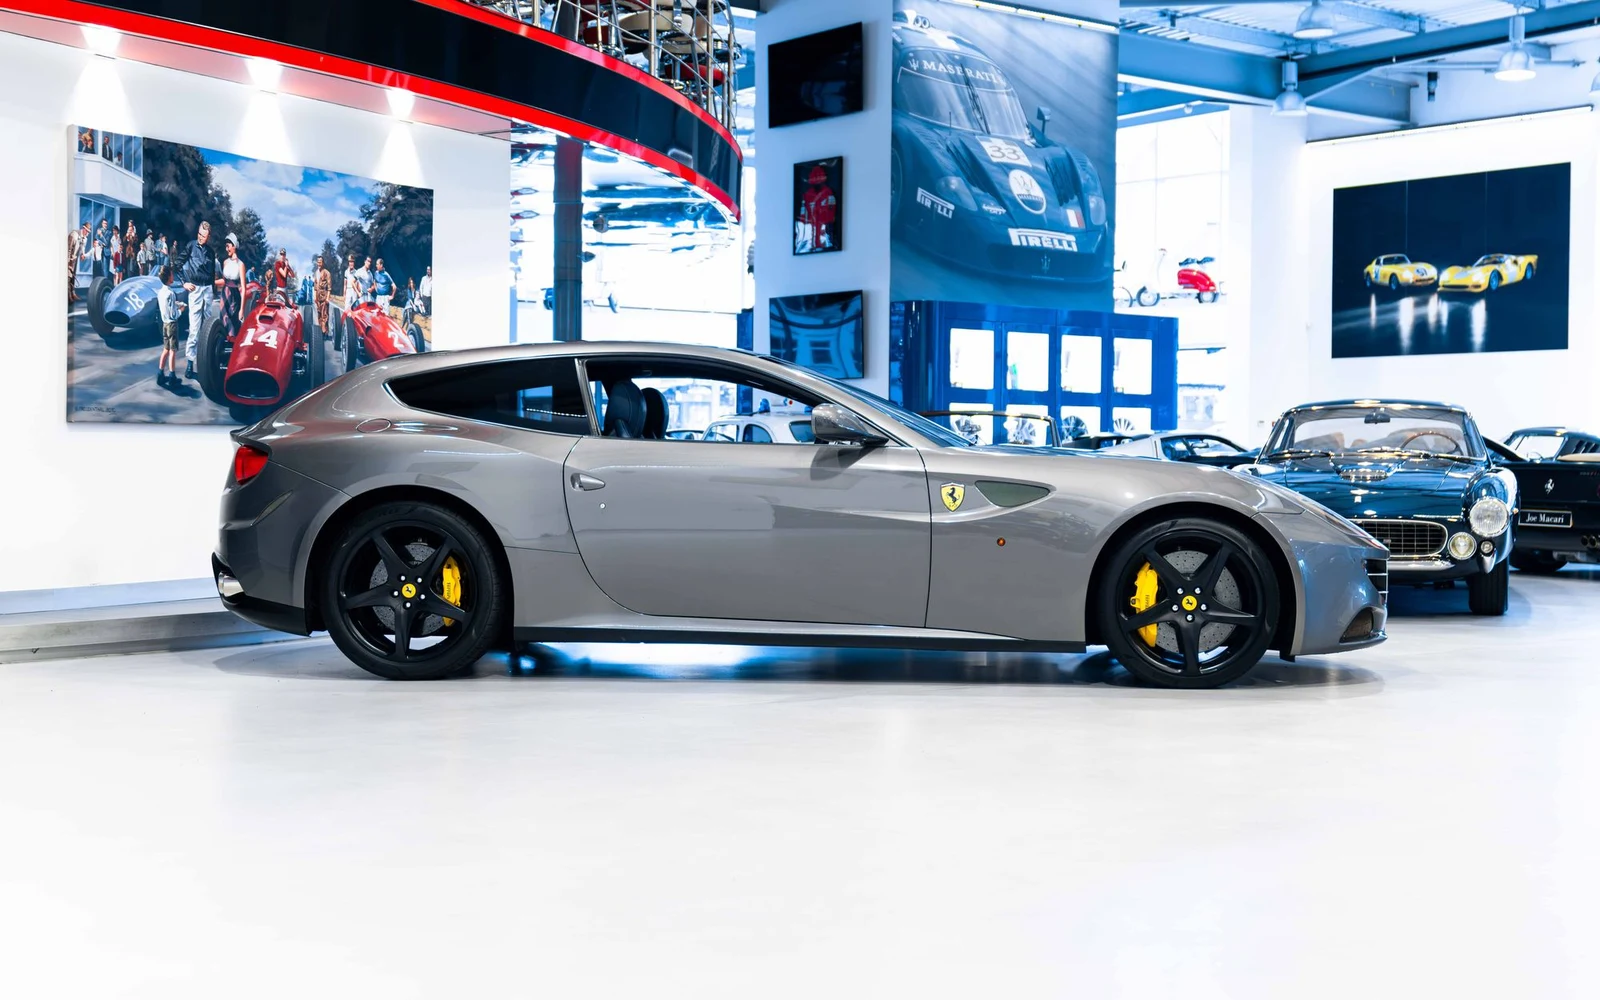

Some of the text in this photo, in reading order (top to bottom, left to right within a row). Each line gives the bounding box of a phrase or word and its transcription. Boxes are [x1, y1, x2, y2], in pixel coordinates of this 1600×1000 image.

[922, 59, 998, 84] MASERATI
[988, 145, 1021, 161] 33
[1007, 227, 1079, 252] PIRELLI
[124, 292, 145, 311] 18
[240, 328, 278, 349] 14
[1526, 512, 1564, 524] Joe Macari
